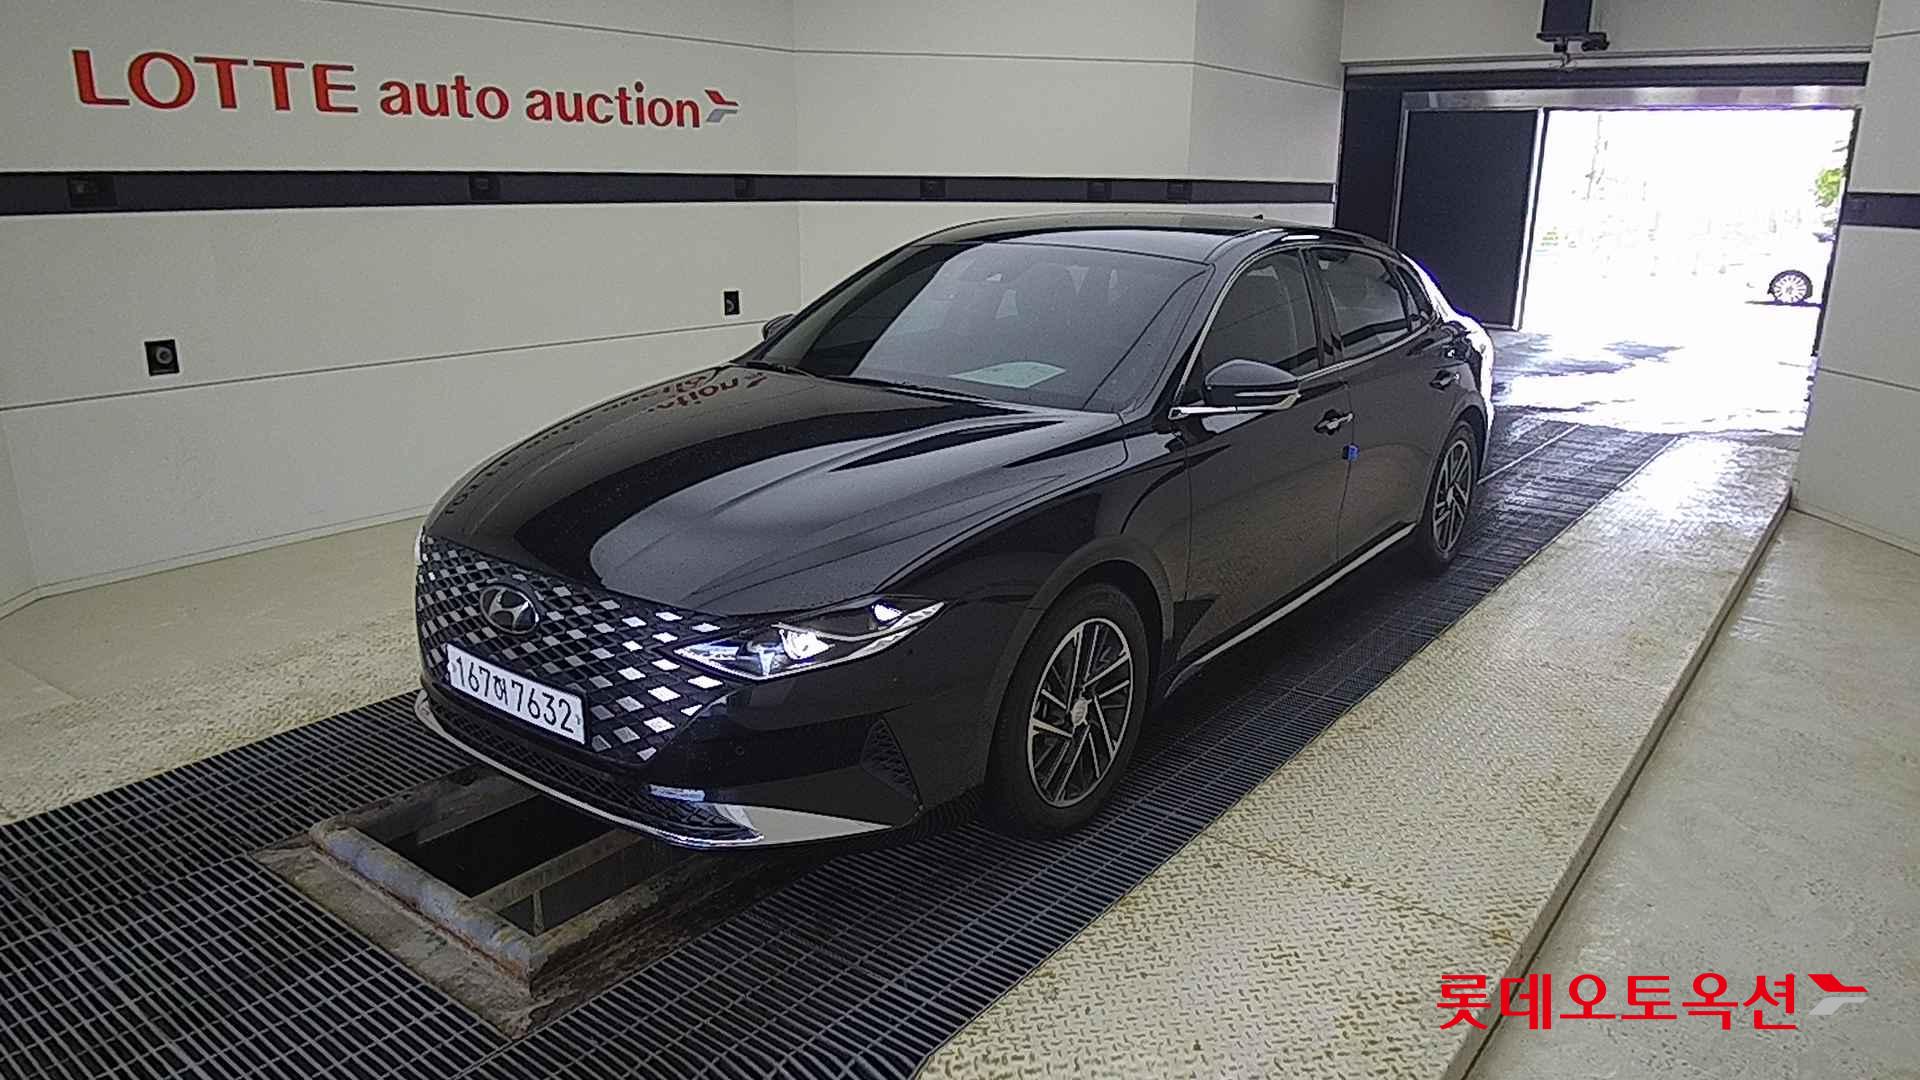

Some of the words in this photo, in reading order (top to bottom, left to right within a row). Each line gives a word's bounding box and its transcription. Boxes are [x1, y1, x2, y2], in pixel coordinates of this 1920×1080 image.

[72, 49, 358, 114] LOTTE
[379, 74, 510, 120] auto
[525, 81, 701, 128] auction
